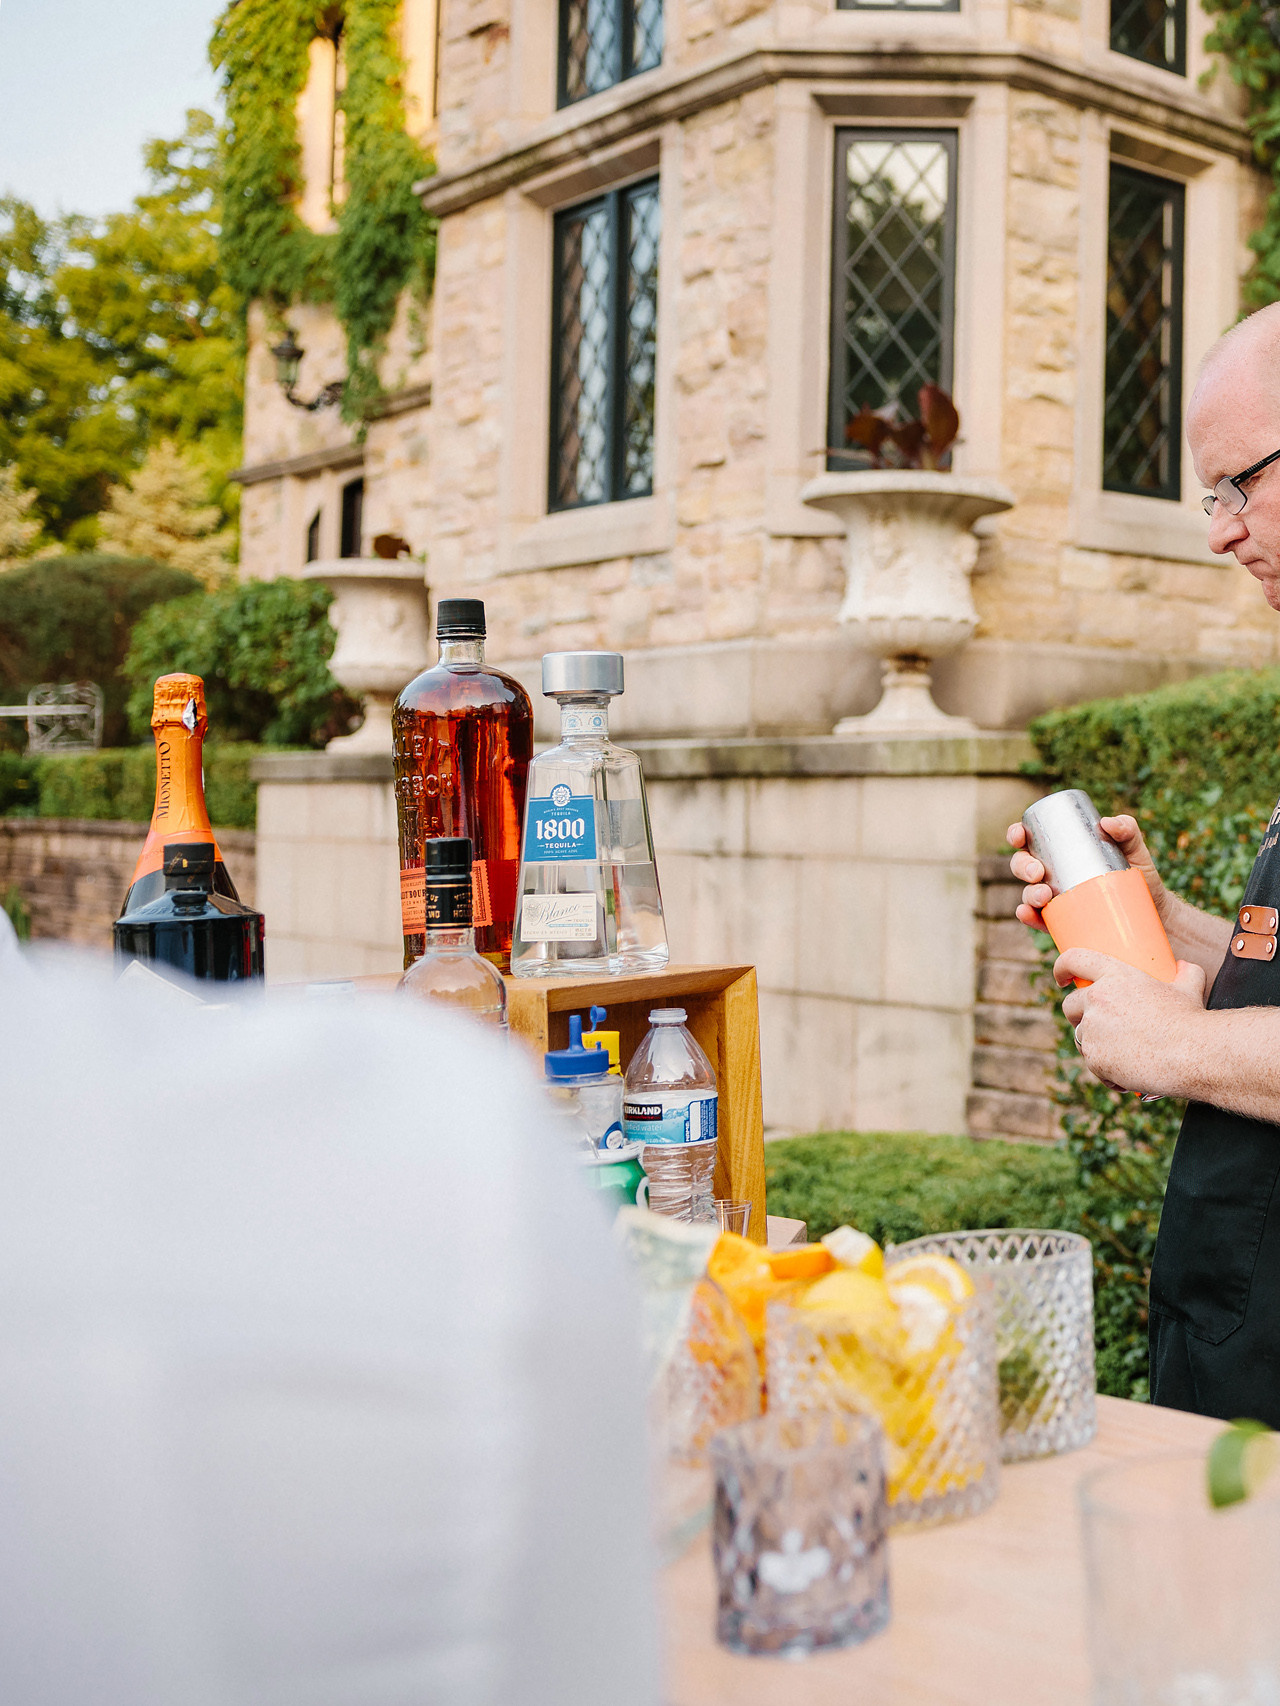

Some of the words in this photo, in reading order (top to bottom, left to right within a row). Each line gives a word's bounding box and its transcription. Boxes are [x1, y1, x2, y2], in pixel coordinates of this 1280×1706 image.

[535, 817, 585, 841] 1800
[531, 901, 580, 926] Blanco
[642, 1123, 662, 1132] water
